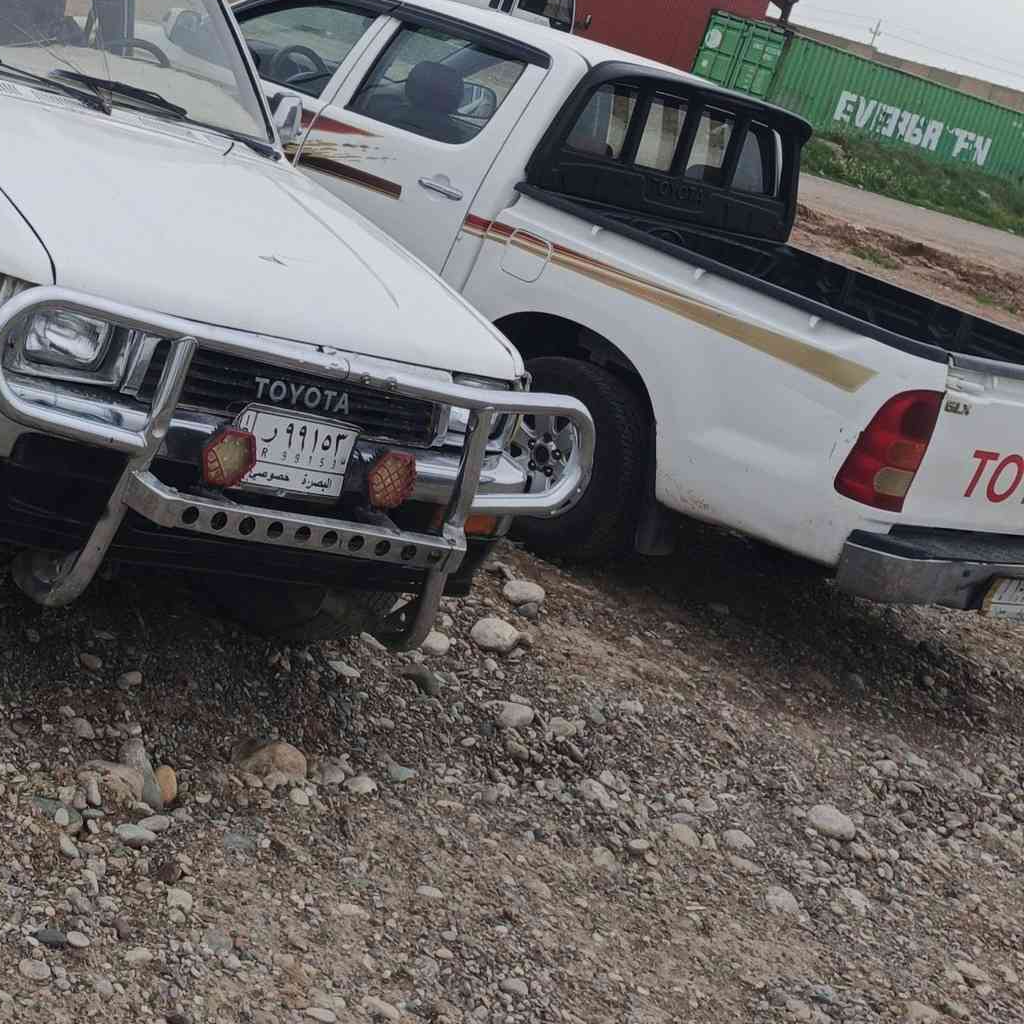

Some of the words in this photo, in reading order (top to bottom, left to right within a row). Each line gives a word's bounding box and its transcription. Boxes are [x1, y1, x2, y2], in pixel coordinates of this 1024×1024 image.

[255, 376, 350, 414] TOYOTA
[286, 422, 348, 457] ٩٩١٥٣
[301, 474, 332, 492] البصرة
